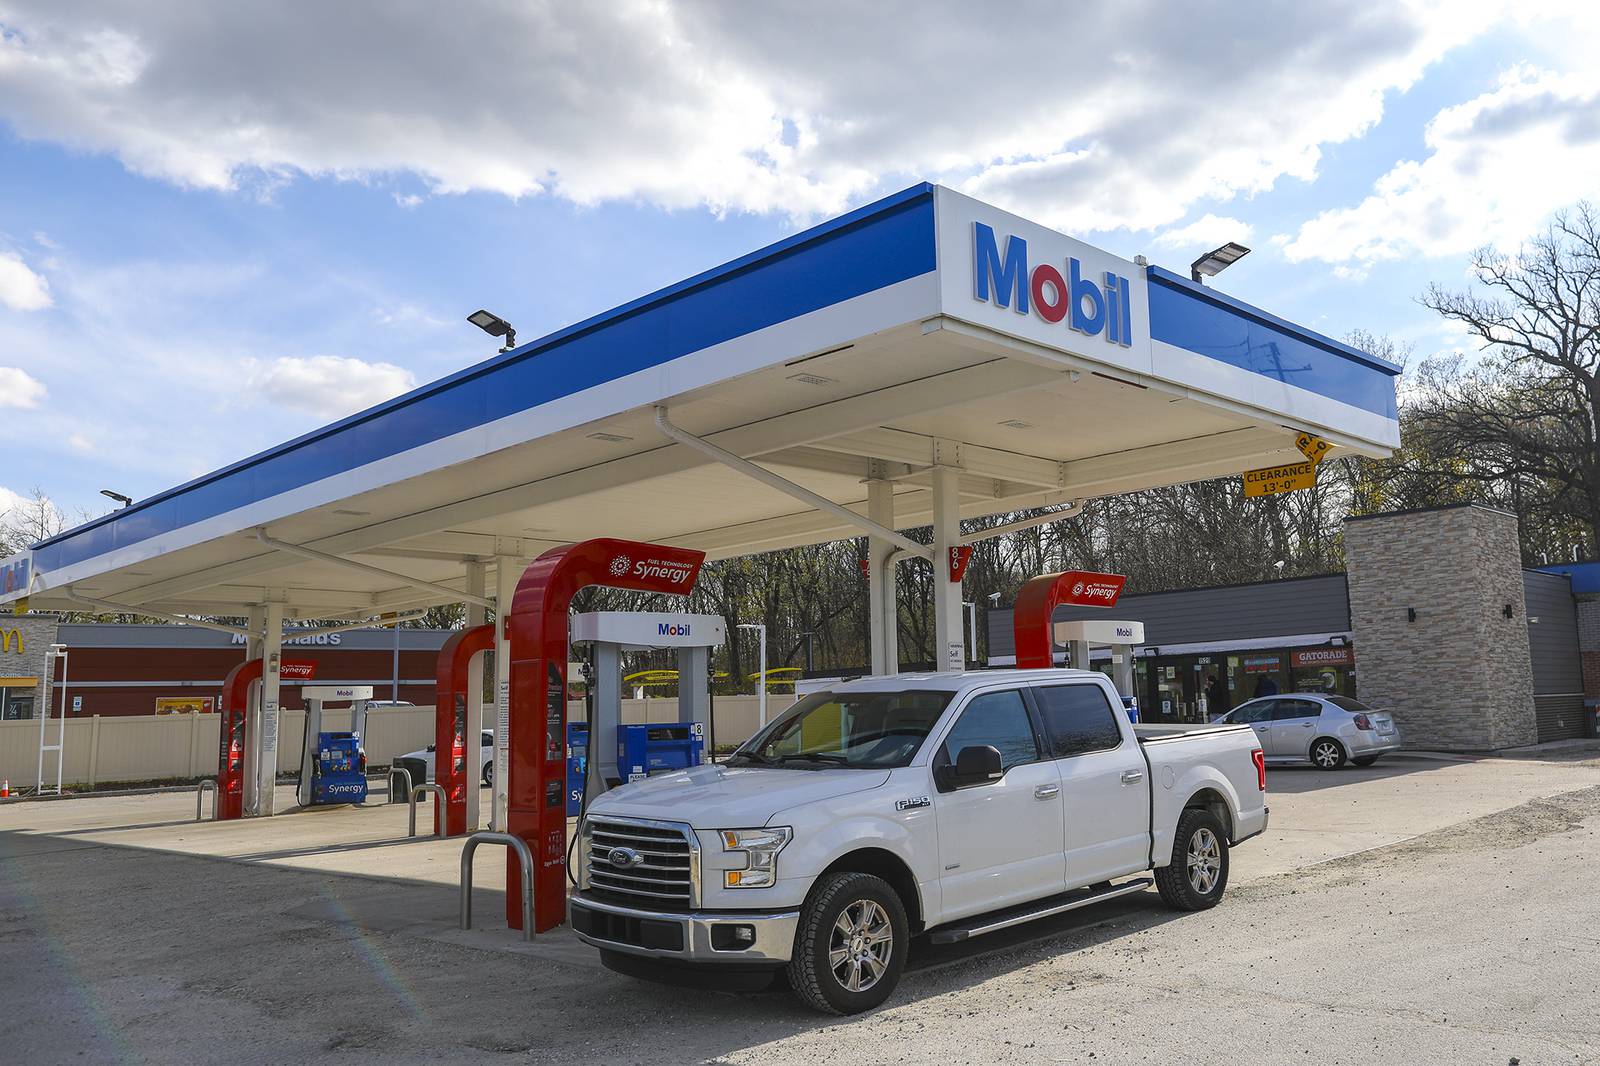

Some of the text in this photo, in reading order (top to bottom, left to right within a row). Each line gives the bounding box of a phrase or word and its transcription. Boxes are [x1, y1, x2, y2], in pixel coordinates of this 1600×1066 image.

[971, 220, 1133, 348] Mobil
[1247, 464, 1311, 483] CLEARANCE
[1263, 479, 1296, 493] 13'-0"
[661, 560, 694, 568] TECHNOLOGY
[633, 561, 691, 584] Synergy
[1085, 585, 1117, 600] Synergy
[658, 623, 691, 636] Mobil
[1116, 628, 1133, 637] Mobil
[1299, 649, 1347, 661] GATORADE
[280, 665, 312, 675] Synergy
[696, 724, 702, 734] 8
[329, 785, 364, 795] Synergy
